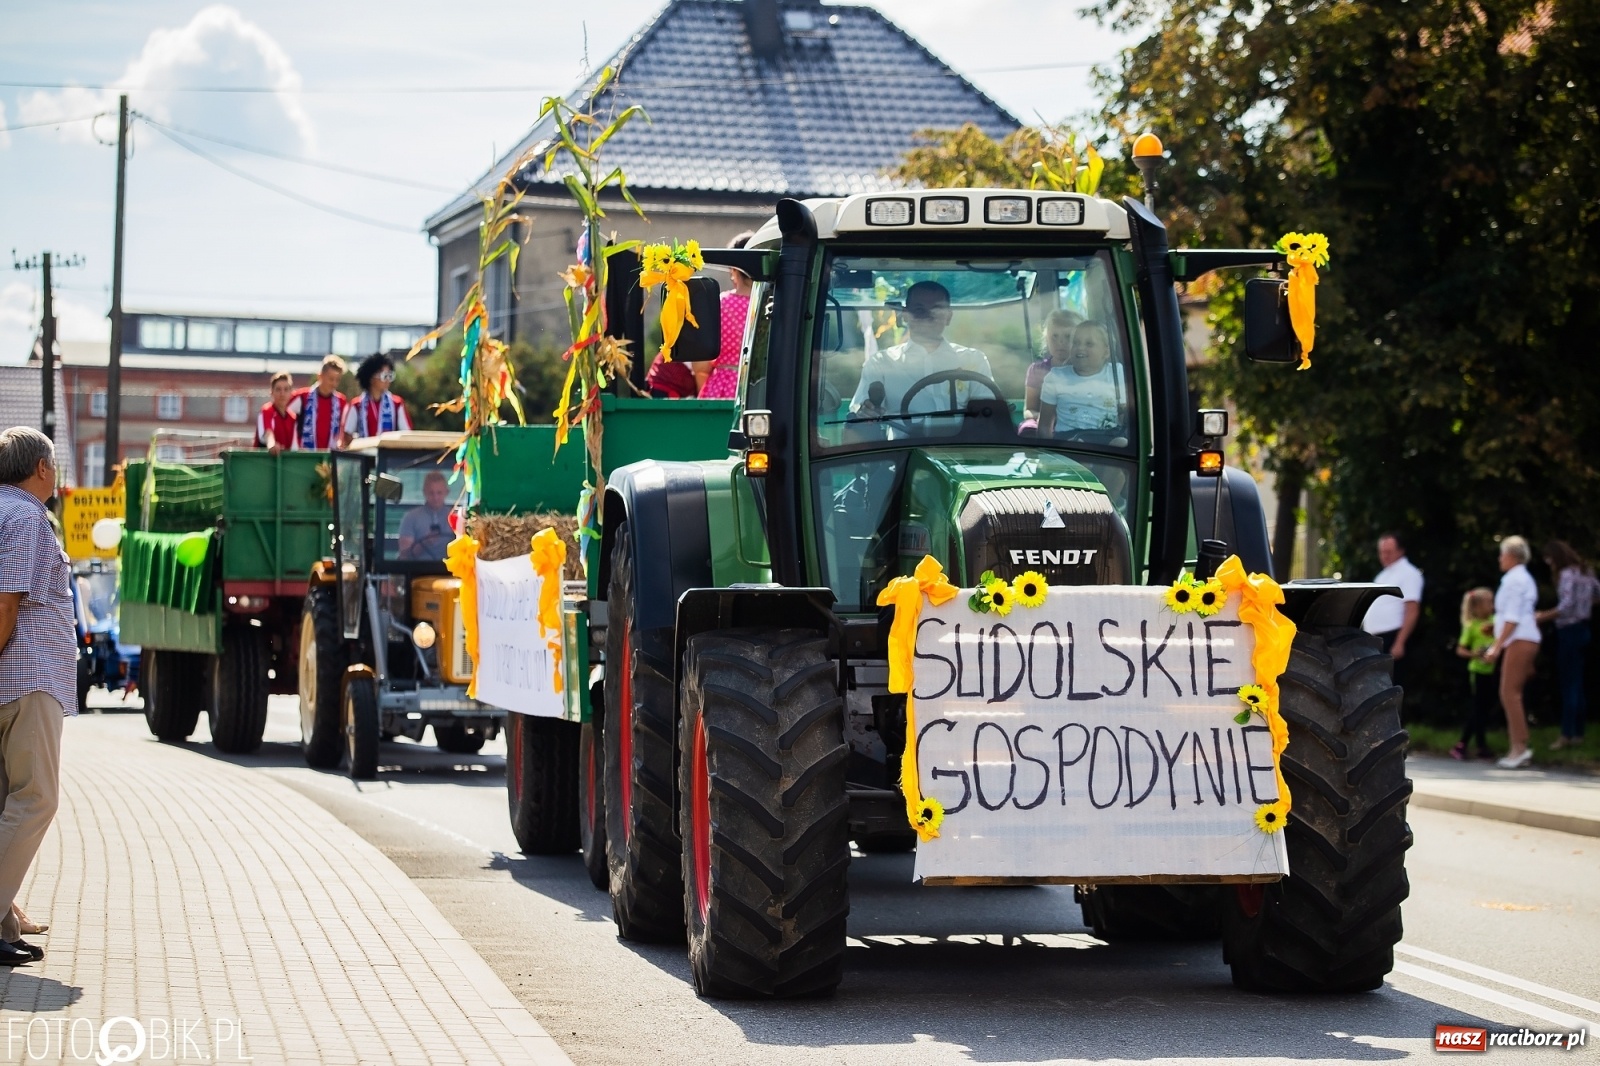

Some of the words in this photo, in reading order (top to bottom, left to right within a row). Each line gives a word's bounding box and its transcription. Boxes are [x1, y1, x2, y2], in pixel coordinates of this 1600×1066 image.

[1009, 549, 1098, 565] FENDT
[912, 618, 1243, 704] SUDOLSKIE
[916, 718, 1280, 814] GOSPODYNIE
